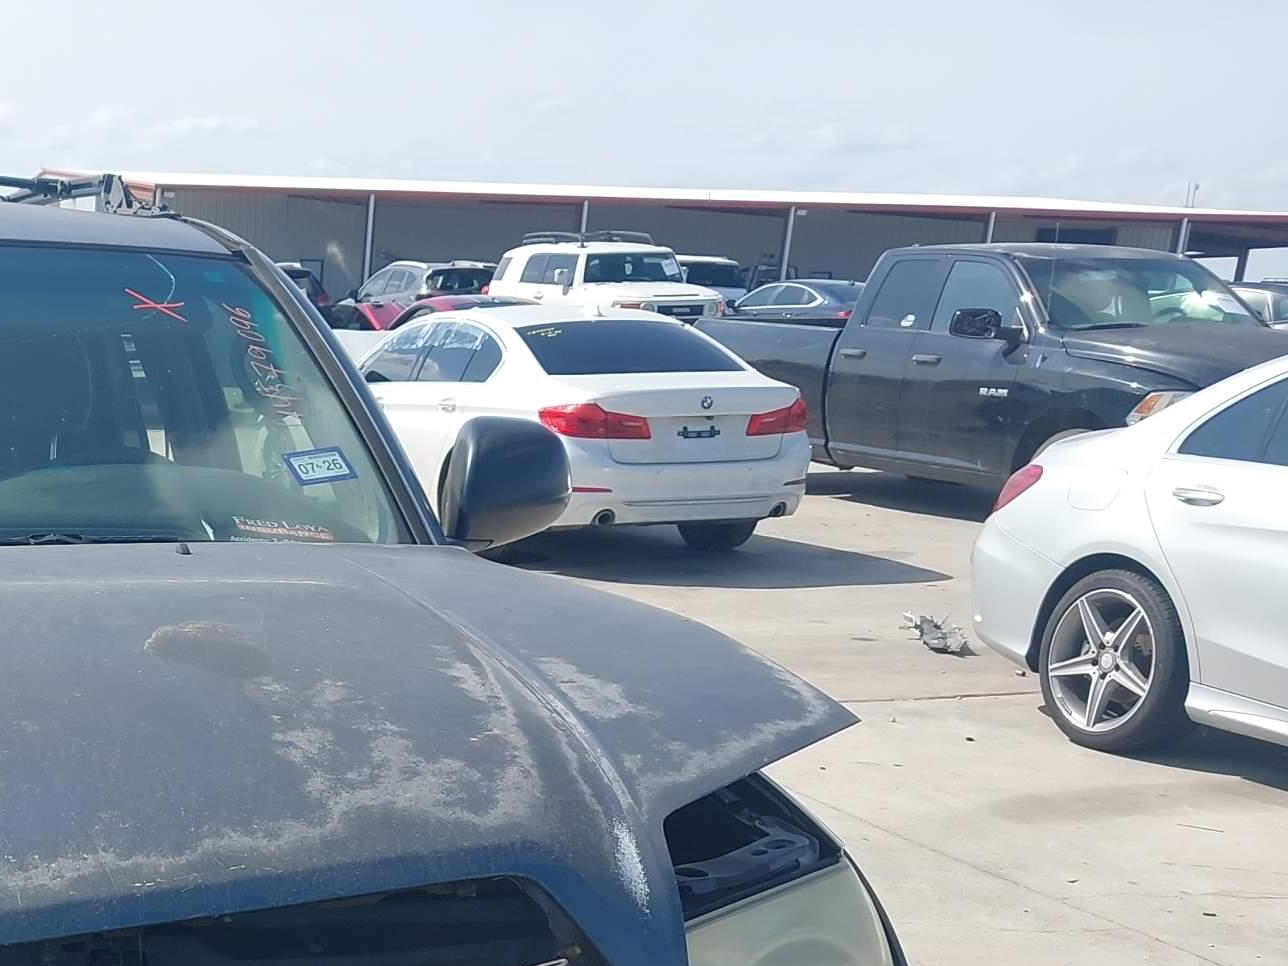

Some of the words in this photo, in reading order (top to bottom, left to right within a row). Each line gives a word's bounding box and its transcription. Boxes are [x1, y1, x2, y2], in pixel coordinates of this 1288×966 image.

[978, 387, 1009, 397] RAM
[297, 462, 316, 475] 07
[322, 458, 343, 471] 26
